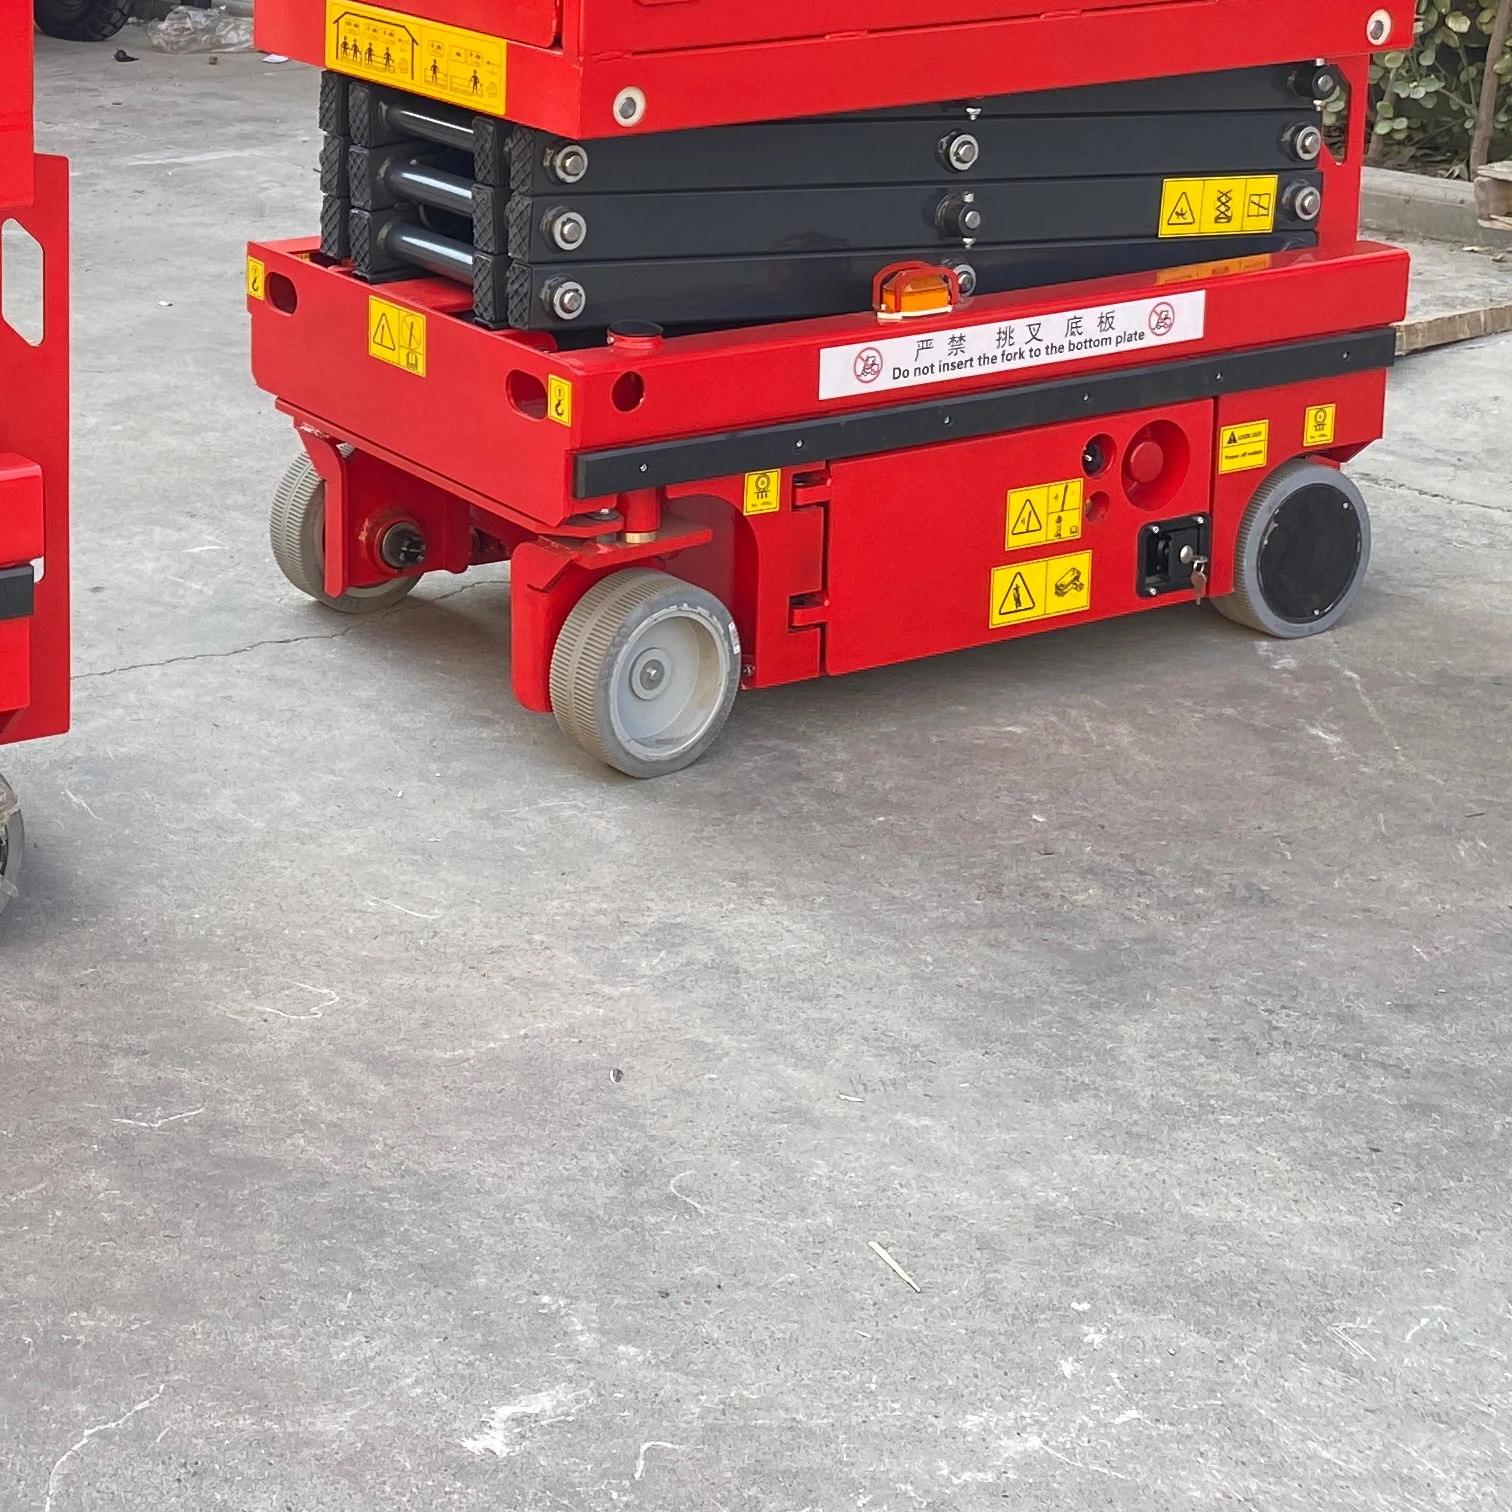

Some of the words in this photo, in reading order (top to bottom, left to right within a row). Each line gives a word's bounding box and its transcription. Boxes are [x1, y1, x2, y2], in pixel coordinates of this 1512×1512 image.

[892, 366, 910, 381] Do
[913, 362, 936, 378] not
[938, 356, 975, 374] insert
[976, 352, 998, 367] the
[1000, 347, 1026, 363] fork
[1028, 346, 1042, 359] to
[1044, 342, 1065, 356] the
[1067, 336, 1112, 353] bottom
[1115, 330, 1146, 347] plate
